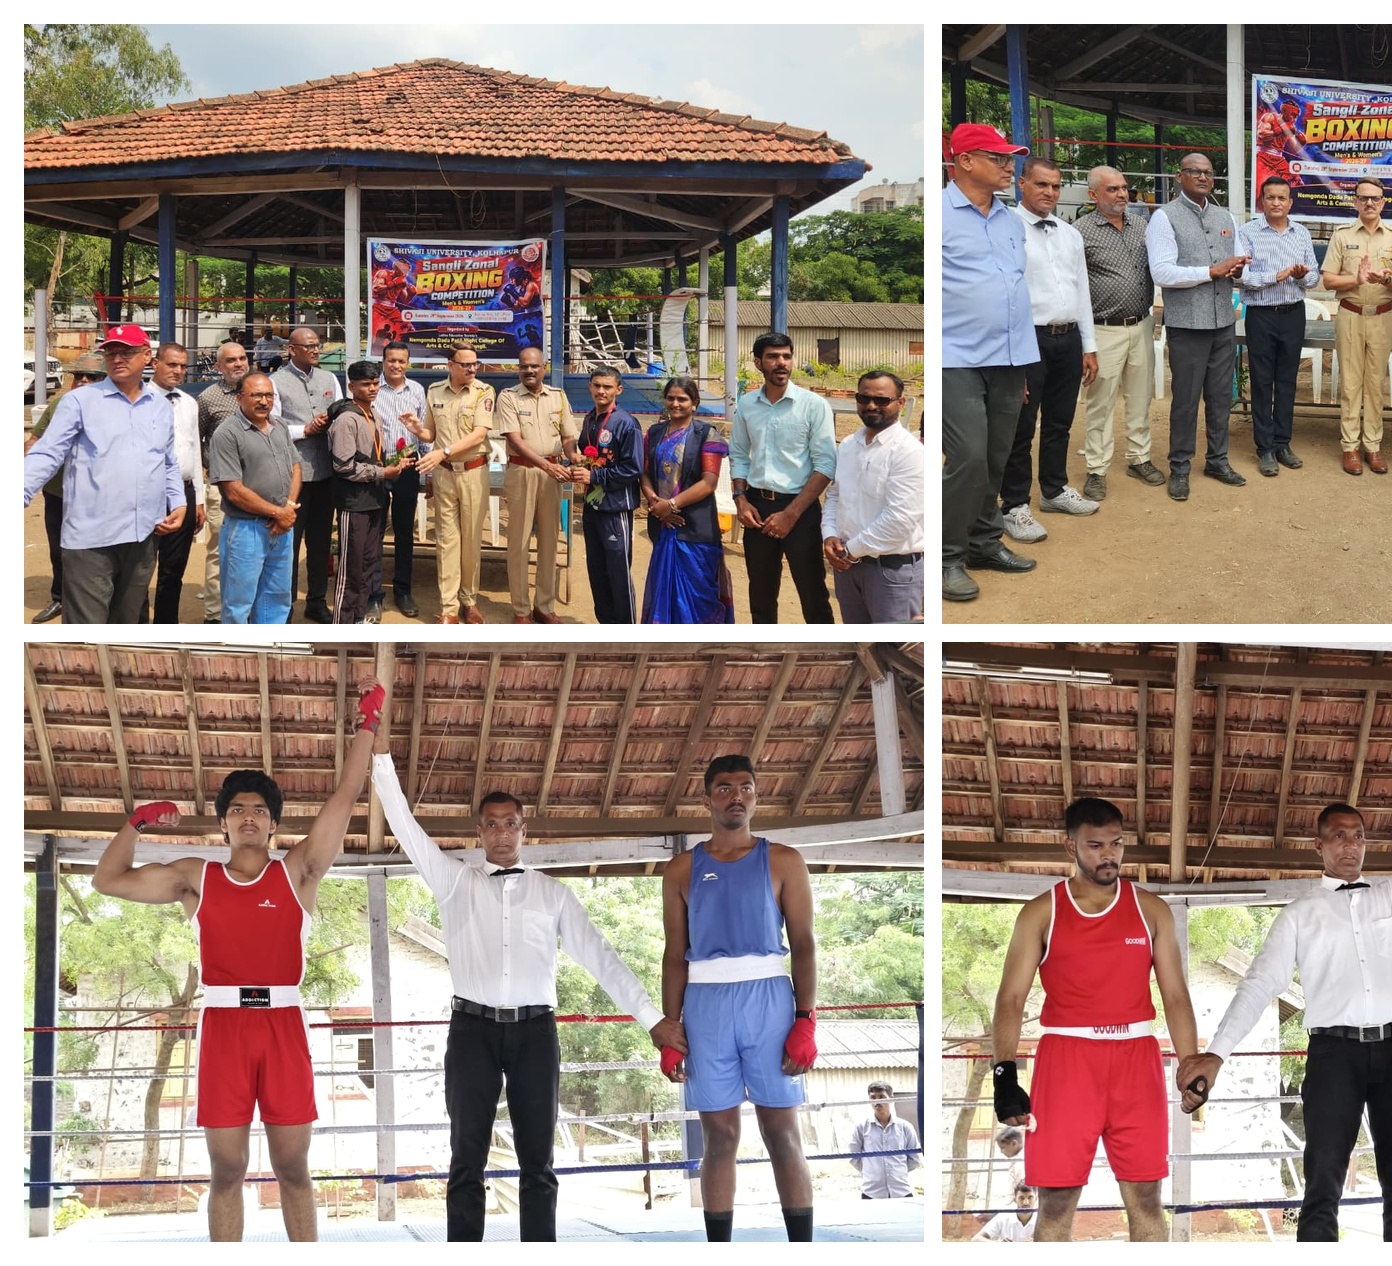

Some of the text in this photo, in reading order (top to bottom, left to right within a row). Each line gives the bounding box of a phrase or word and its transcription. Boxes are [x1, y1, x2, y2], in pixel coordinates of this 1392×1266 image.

[1282, 87, 1317, 97] SHIVAJI
[1313, 104, 1358, 118] Sangli
[1297, 192, 1328, 200] Nemgonda
[394, 247, 425, 255] SHIVAJI
[477, 248, 519, 257] KOLHAPUR
[422, 258, 499, 272] Sangli Zonal
[416, 270, 503, 294] BOXING
[431, 289, 495, 300] COMPETITION
